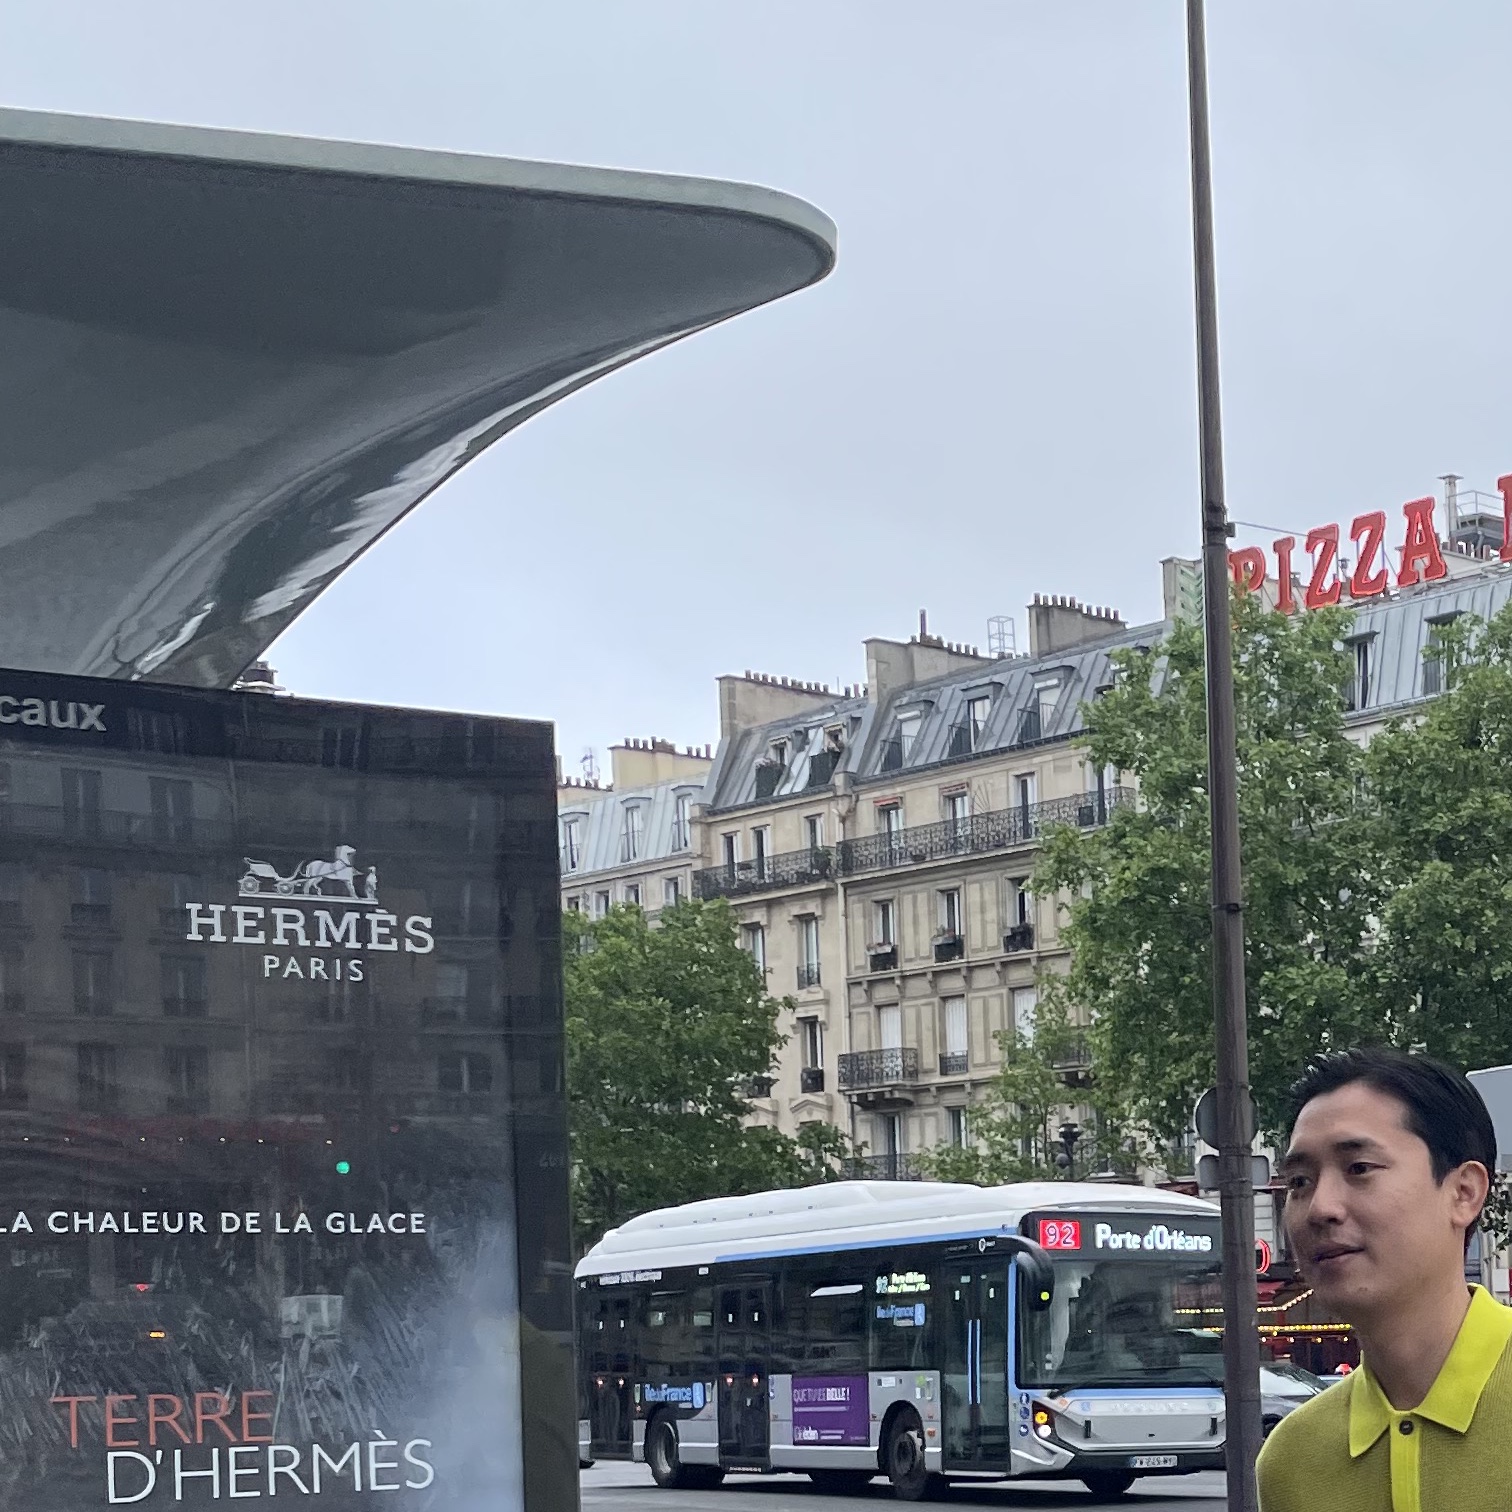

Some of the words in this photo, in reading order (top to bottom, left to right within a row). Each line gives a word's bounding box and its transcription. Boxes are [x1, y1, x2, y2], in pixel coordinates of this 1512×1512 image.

[1228, 496, 1447, 616] PIZZA
[0, 695, 107, 732] caux
[185, 902, 435, 955] HERMÈS
[263, 955, 364, 982] PARIS
[0, 1211, 34, 1233] A
[47, 1211, 207, 1233] CHALEUR
[220, 1211, 261, 1234] DE
[274, 1211, 312, 1234] LA
[325, 1211, 427, 1235] GLACE
[1045, 1223, 1076, 1247] 92
[1095, 1223, 1141, 1249] Porte
[1143, 1225, 1213, 1251] d'Orléans
[50, 1388, 274, 1449] TERRE
[105, 1429, 435, 1505] D'HERMÈS
